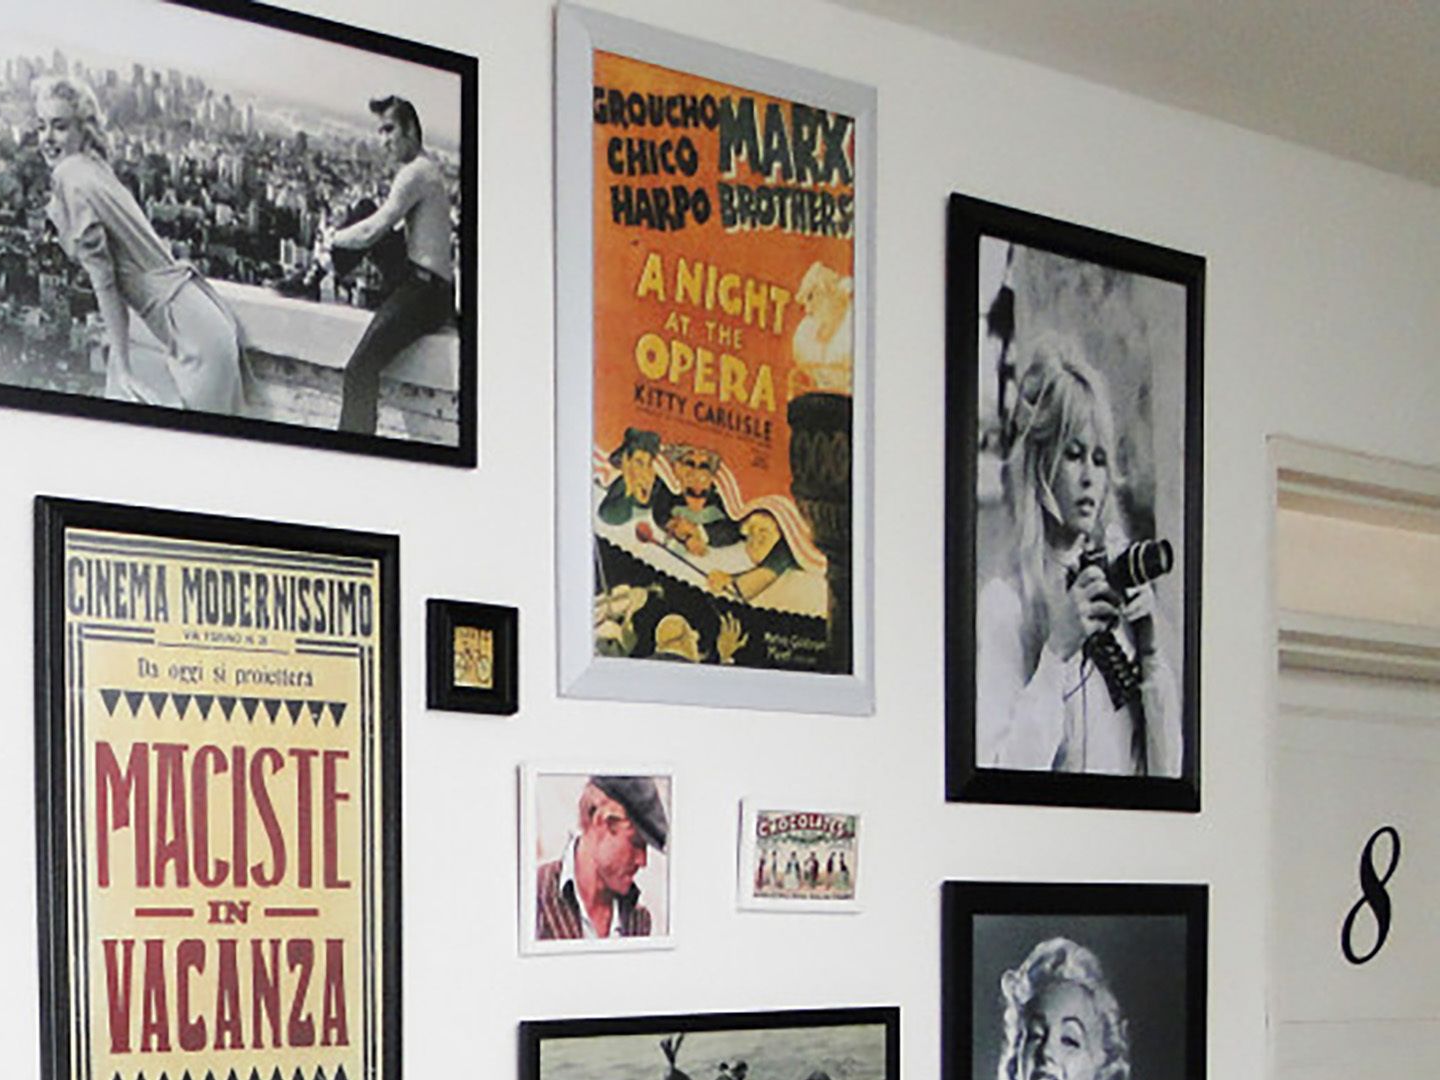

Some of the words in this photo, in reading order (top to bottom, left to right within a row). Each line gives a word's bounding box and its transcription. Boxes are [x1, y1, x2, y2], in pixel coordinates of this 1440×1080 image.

[593, 86, 720, 130] GROUCHO
[719, 96, 855, 186] MARX
[607, 136, 698, 177] CHICO
[610, 185, 711, 231] HARPO
[717, 182, 854, 238] BROTHERS
[637, 252, 665, 301] A
[675, 257, 791, 335] NIGHT
[664, 311, 690, 336] AT
[705, 319, 742, 349] THE
[635, 333, 776, 412] OPERA
[635, 384, 687, 414] KITTY
[694, 401, 772, 441] CARLISLE
[67, 555, 169, 623] CINEMA
[181, 567, 373, 638] MODERNISSIMO
[95, 741, 351, 888] MACISTE
[207, 901, 251, 925] IN
[1341, 826, 1400, 965] 8
[102, 938, 350, 1054] VACANZA
